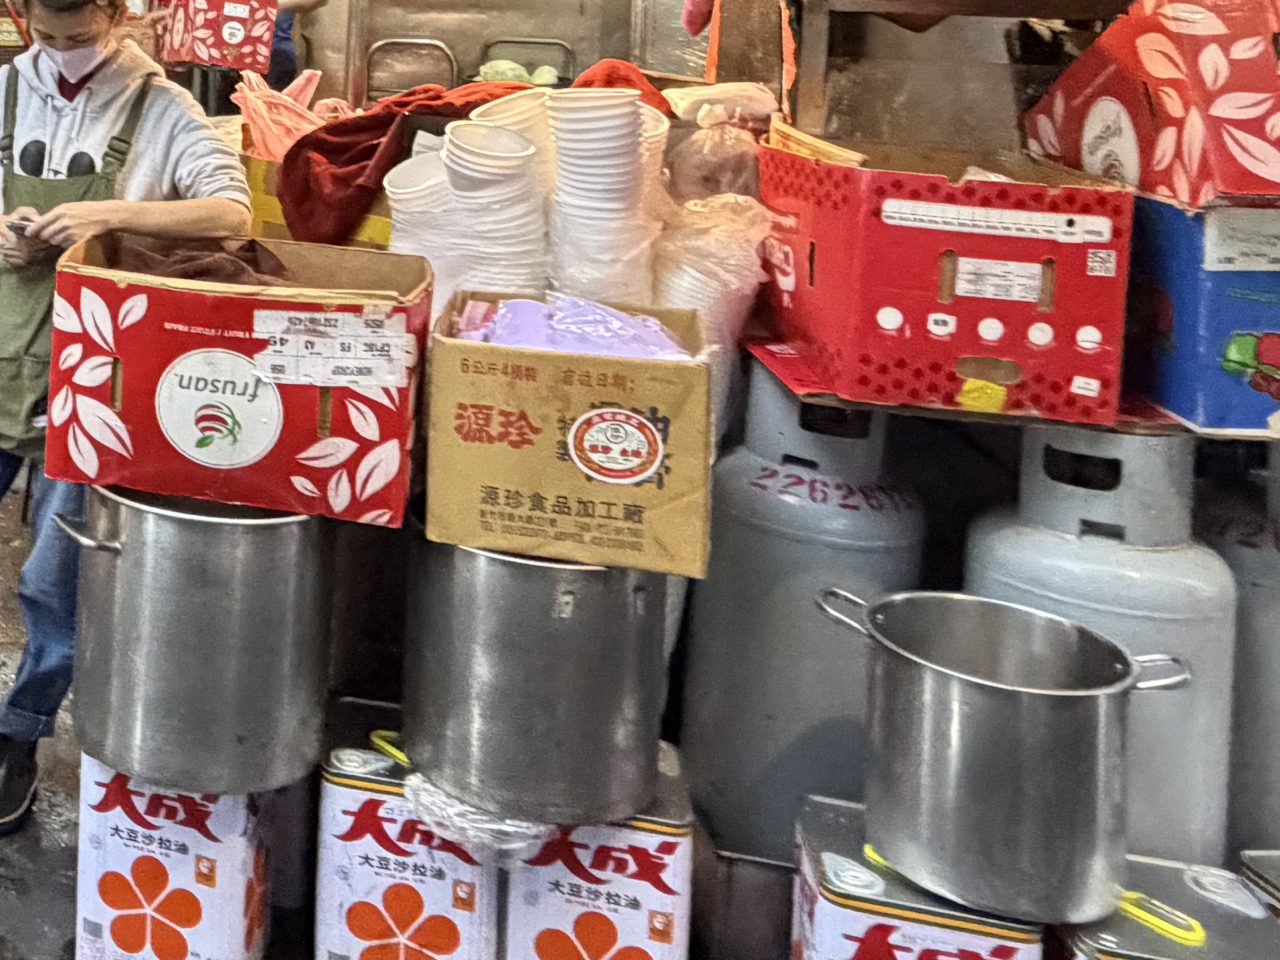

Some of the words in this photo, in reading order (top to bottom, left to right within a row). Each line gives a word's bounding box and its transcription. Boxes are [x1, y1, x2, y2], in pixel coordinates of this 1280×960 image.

[177, 375, 263, 403] frusan
[87, 772, 223, 843] 大成
[109, 823, 190, 856] 大豆沙拉油
[357, 852, 447, 881] 大豆沙拉油
[521, 824, 681, 897] 大成
[547, 879, 642, 912] 大豆沙拉油
